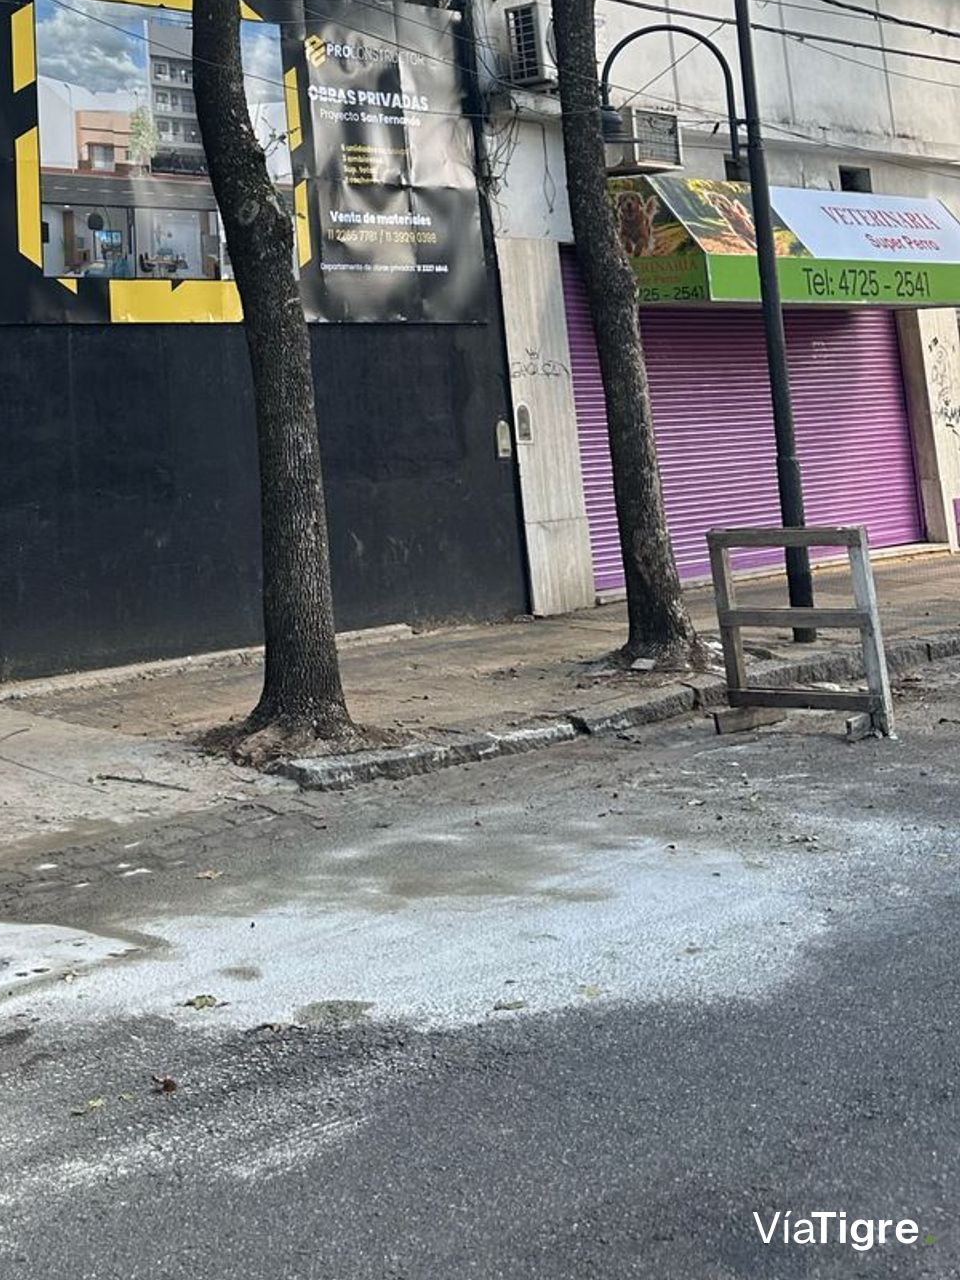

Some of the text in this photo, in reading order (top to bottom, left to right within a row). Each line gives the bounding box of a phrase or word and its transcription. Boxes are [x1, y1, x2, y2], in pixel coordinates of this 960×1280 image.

[308, 85, 429, 111] OBRAS PRIVADAS
[320, 109, 359, 123] Proyecto
[361, 112, 378, 122] San
[330, 210, 431, 226] Venta de materiales
[821, 206, 941, 230] VETERINARIA
[865, 233, 940, 252] Super Perro
[802, 268, 835, 296] Tel:
[839, 269, 879, 297] 4725
[894, 270, 931, 297] 2541
[673, 285, 705, 301] 2541
